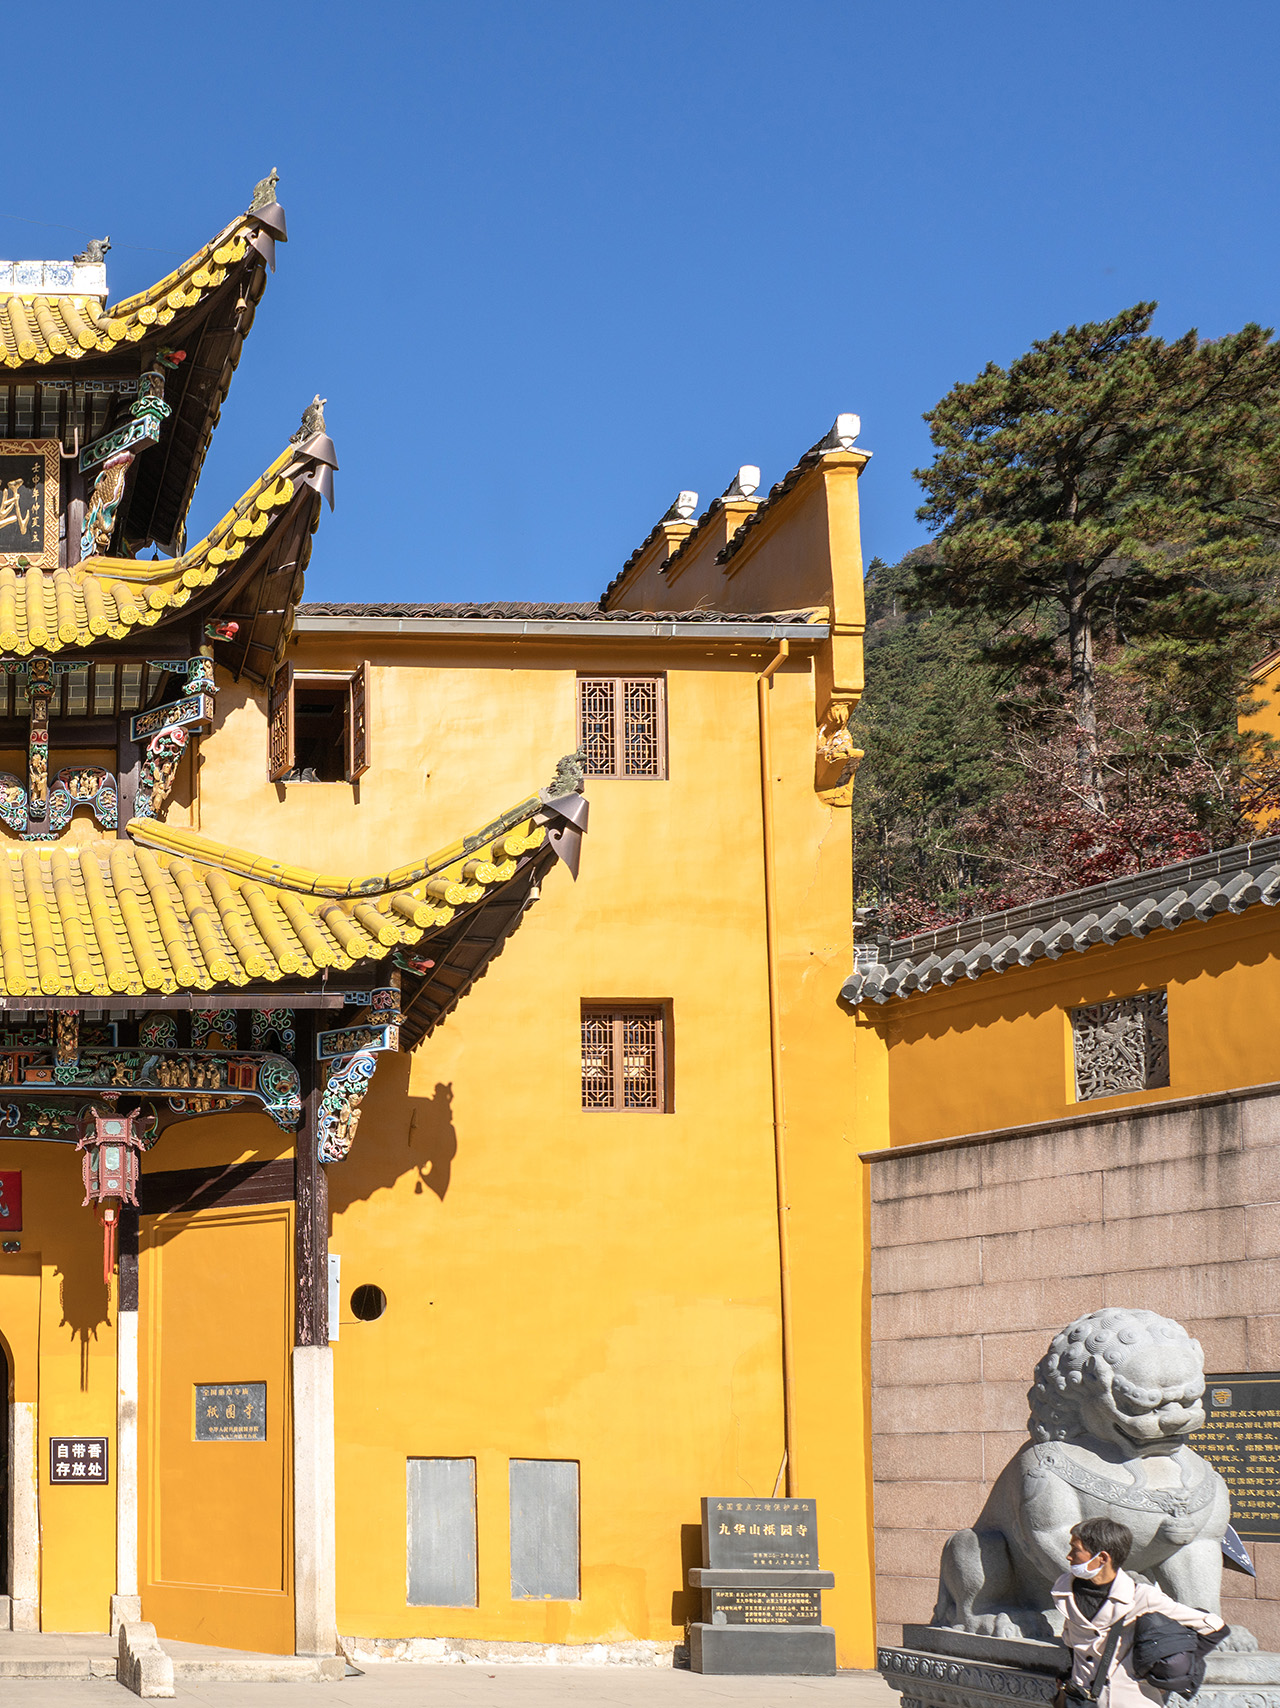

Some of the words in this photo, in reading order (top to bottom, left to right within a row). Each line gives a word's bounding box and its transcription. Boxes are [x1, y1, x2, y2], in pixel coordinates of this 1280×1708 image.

[1213, 1390, 1231, 1404] 寺
[56, 1443, 102, 1459] 自带香
[56, 1461, 103, 1478] 存放处
[716, 1503, 810, 1512] 全国重点文物保护单位
